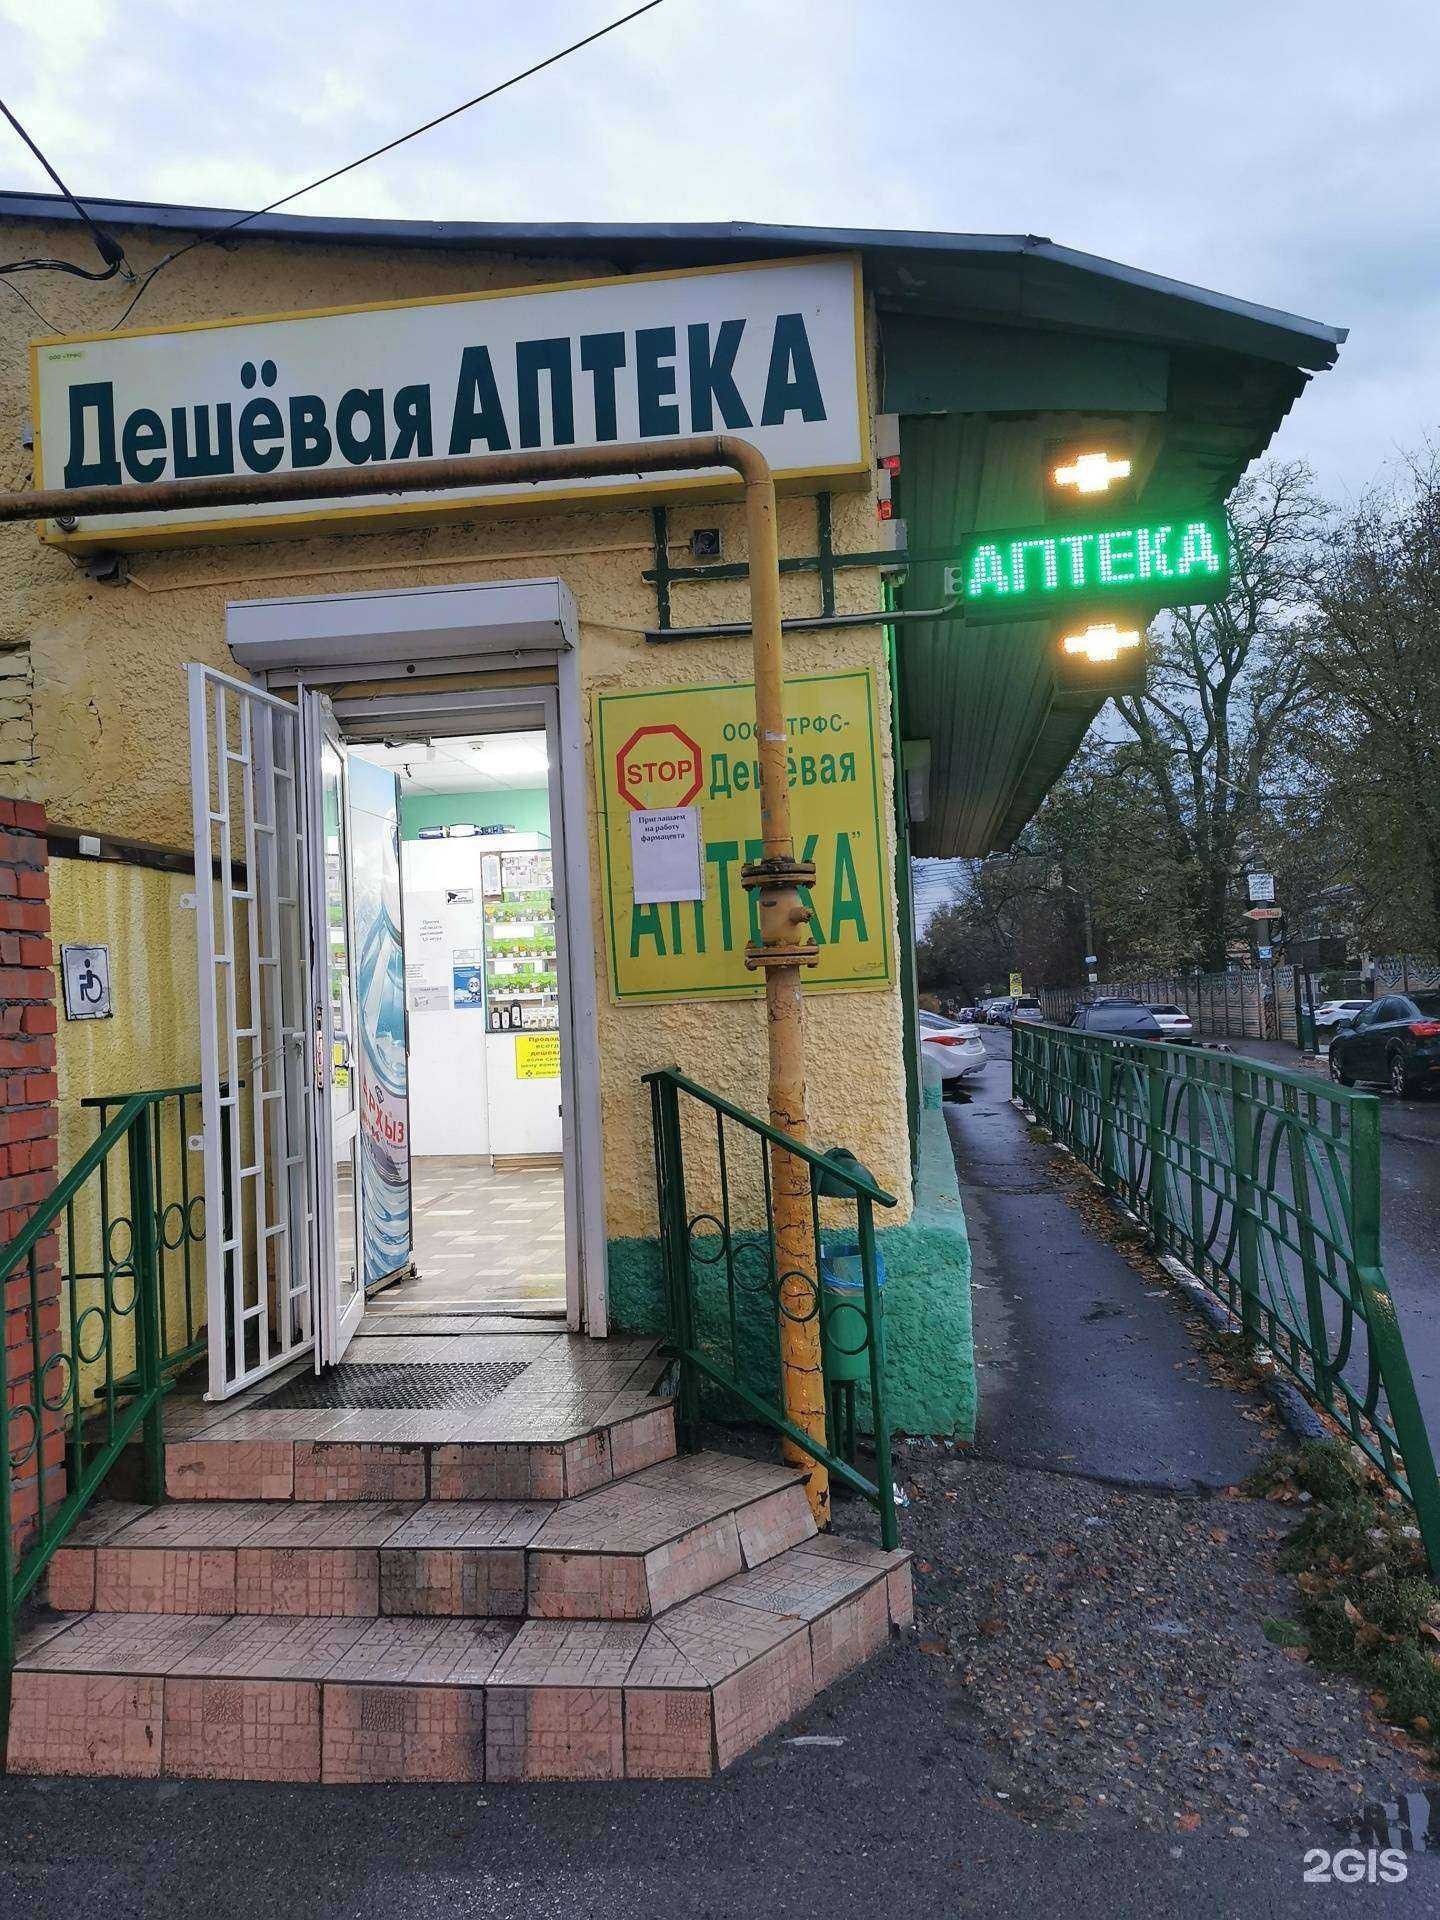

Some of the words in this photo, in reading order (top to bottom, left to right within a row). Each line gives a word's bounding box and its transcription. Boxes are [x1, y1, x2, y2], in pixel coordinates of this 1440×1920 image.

[64, 360, 433, 489] Дешёвая
[449, 313, 827, 455] АПТЕКА
[969, 523, 1220, 595] АПТЕКА
[627, 760, 692, 784] STOP
[638, 814, 687, 825] Приглашаем
[655, 823, 680, 834] работу
